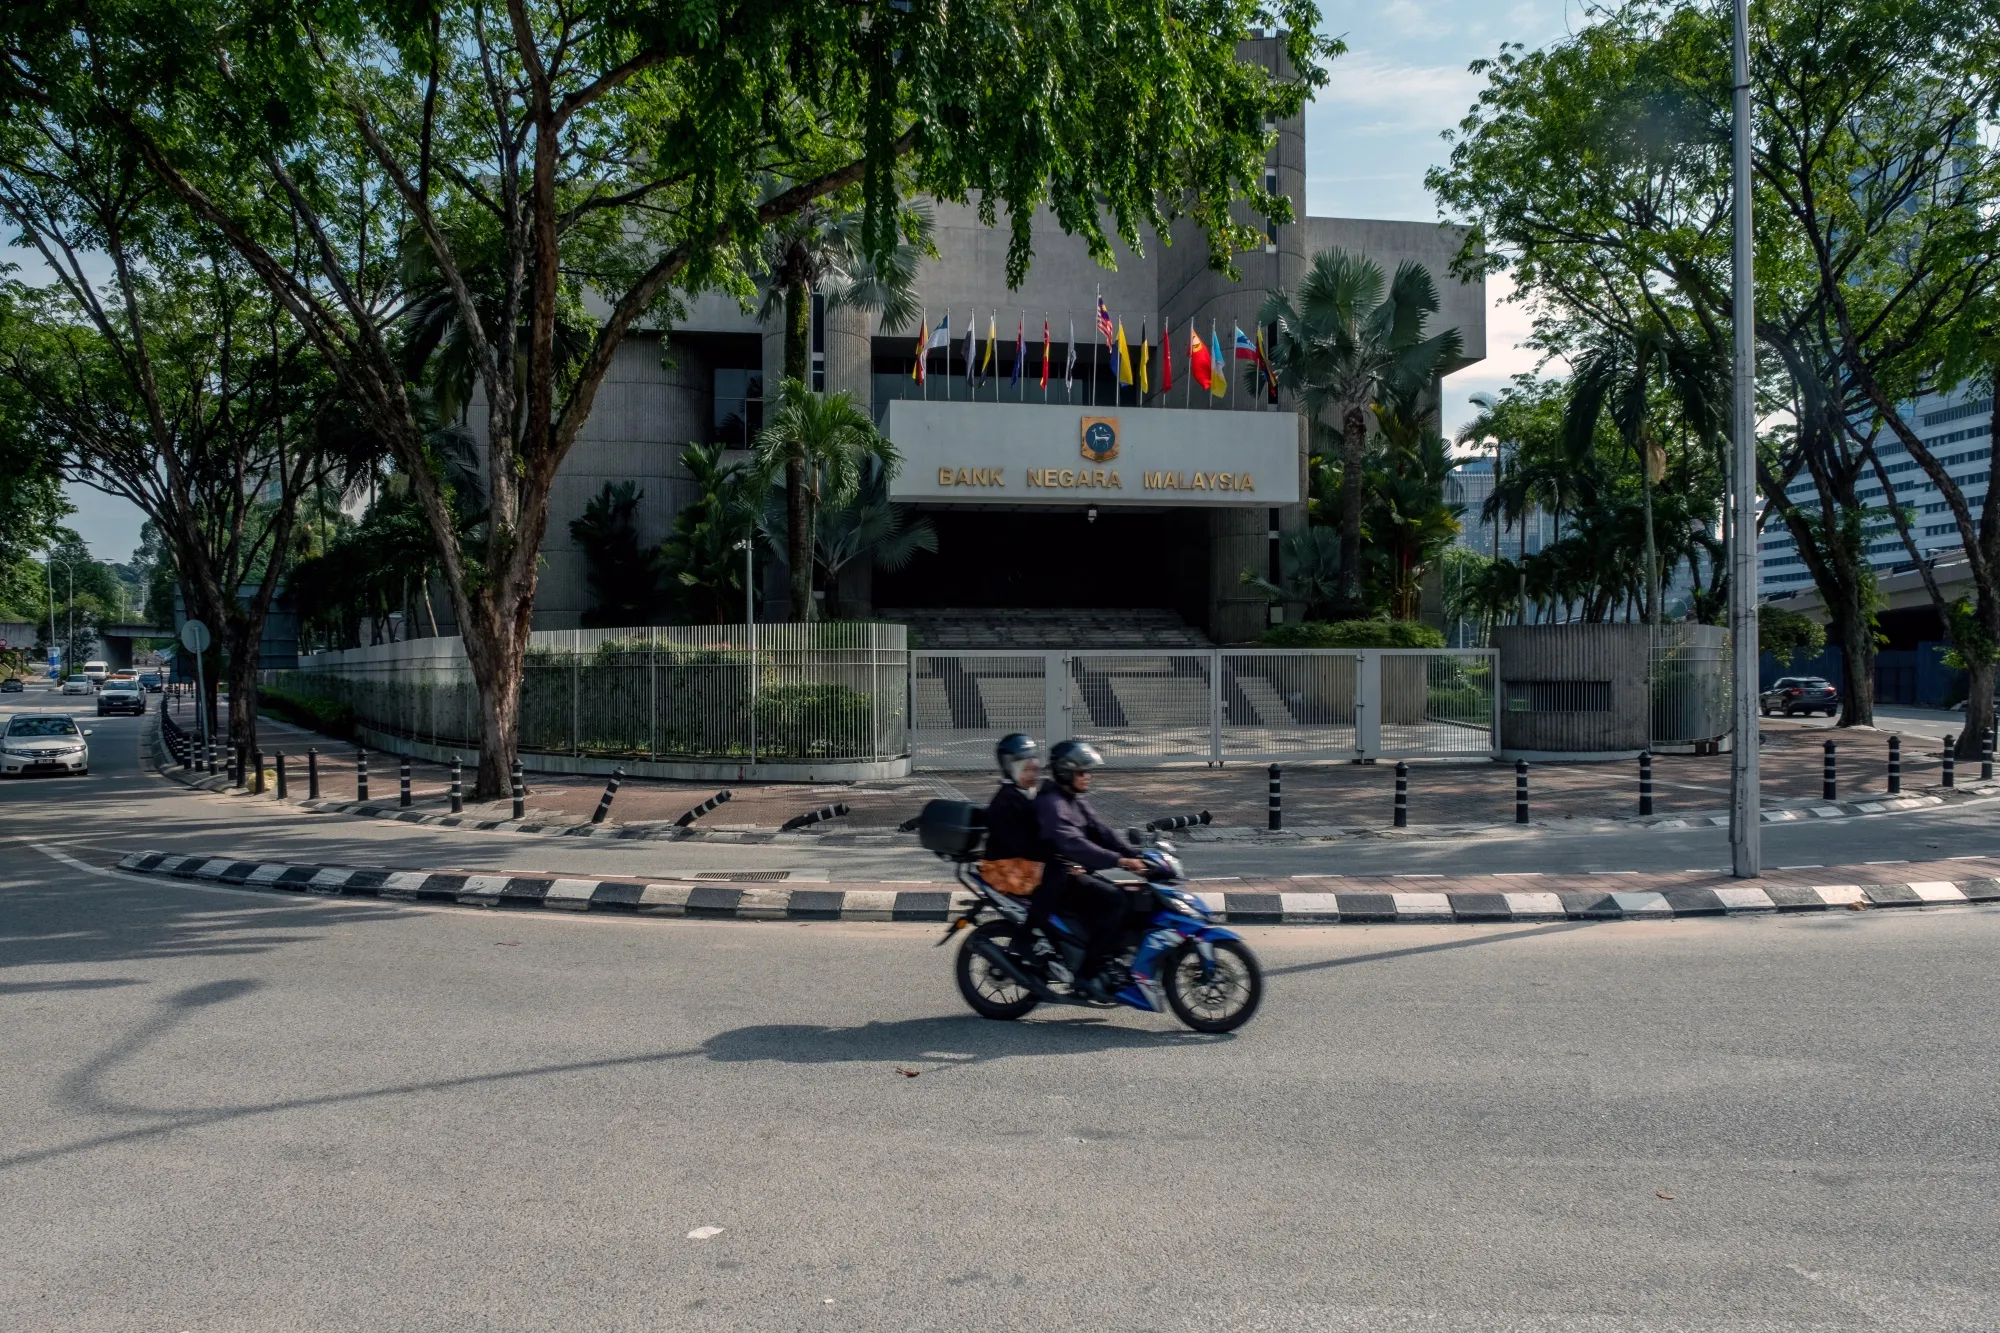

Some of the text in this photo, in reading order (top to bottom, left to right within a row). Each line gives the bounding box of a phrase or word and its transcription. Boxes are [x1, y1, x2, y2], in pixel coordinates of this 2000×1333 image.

[938, 467, 1255, 492] BANK NEGARA MALAYSIA
